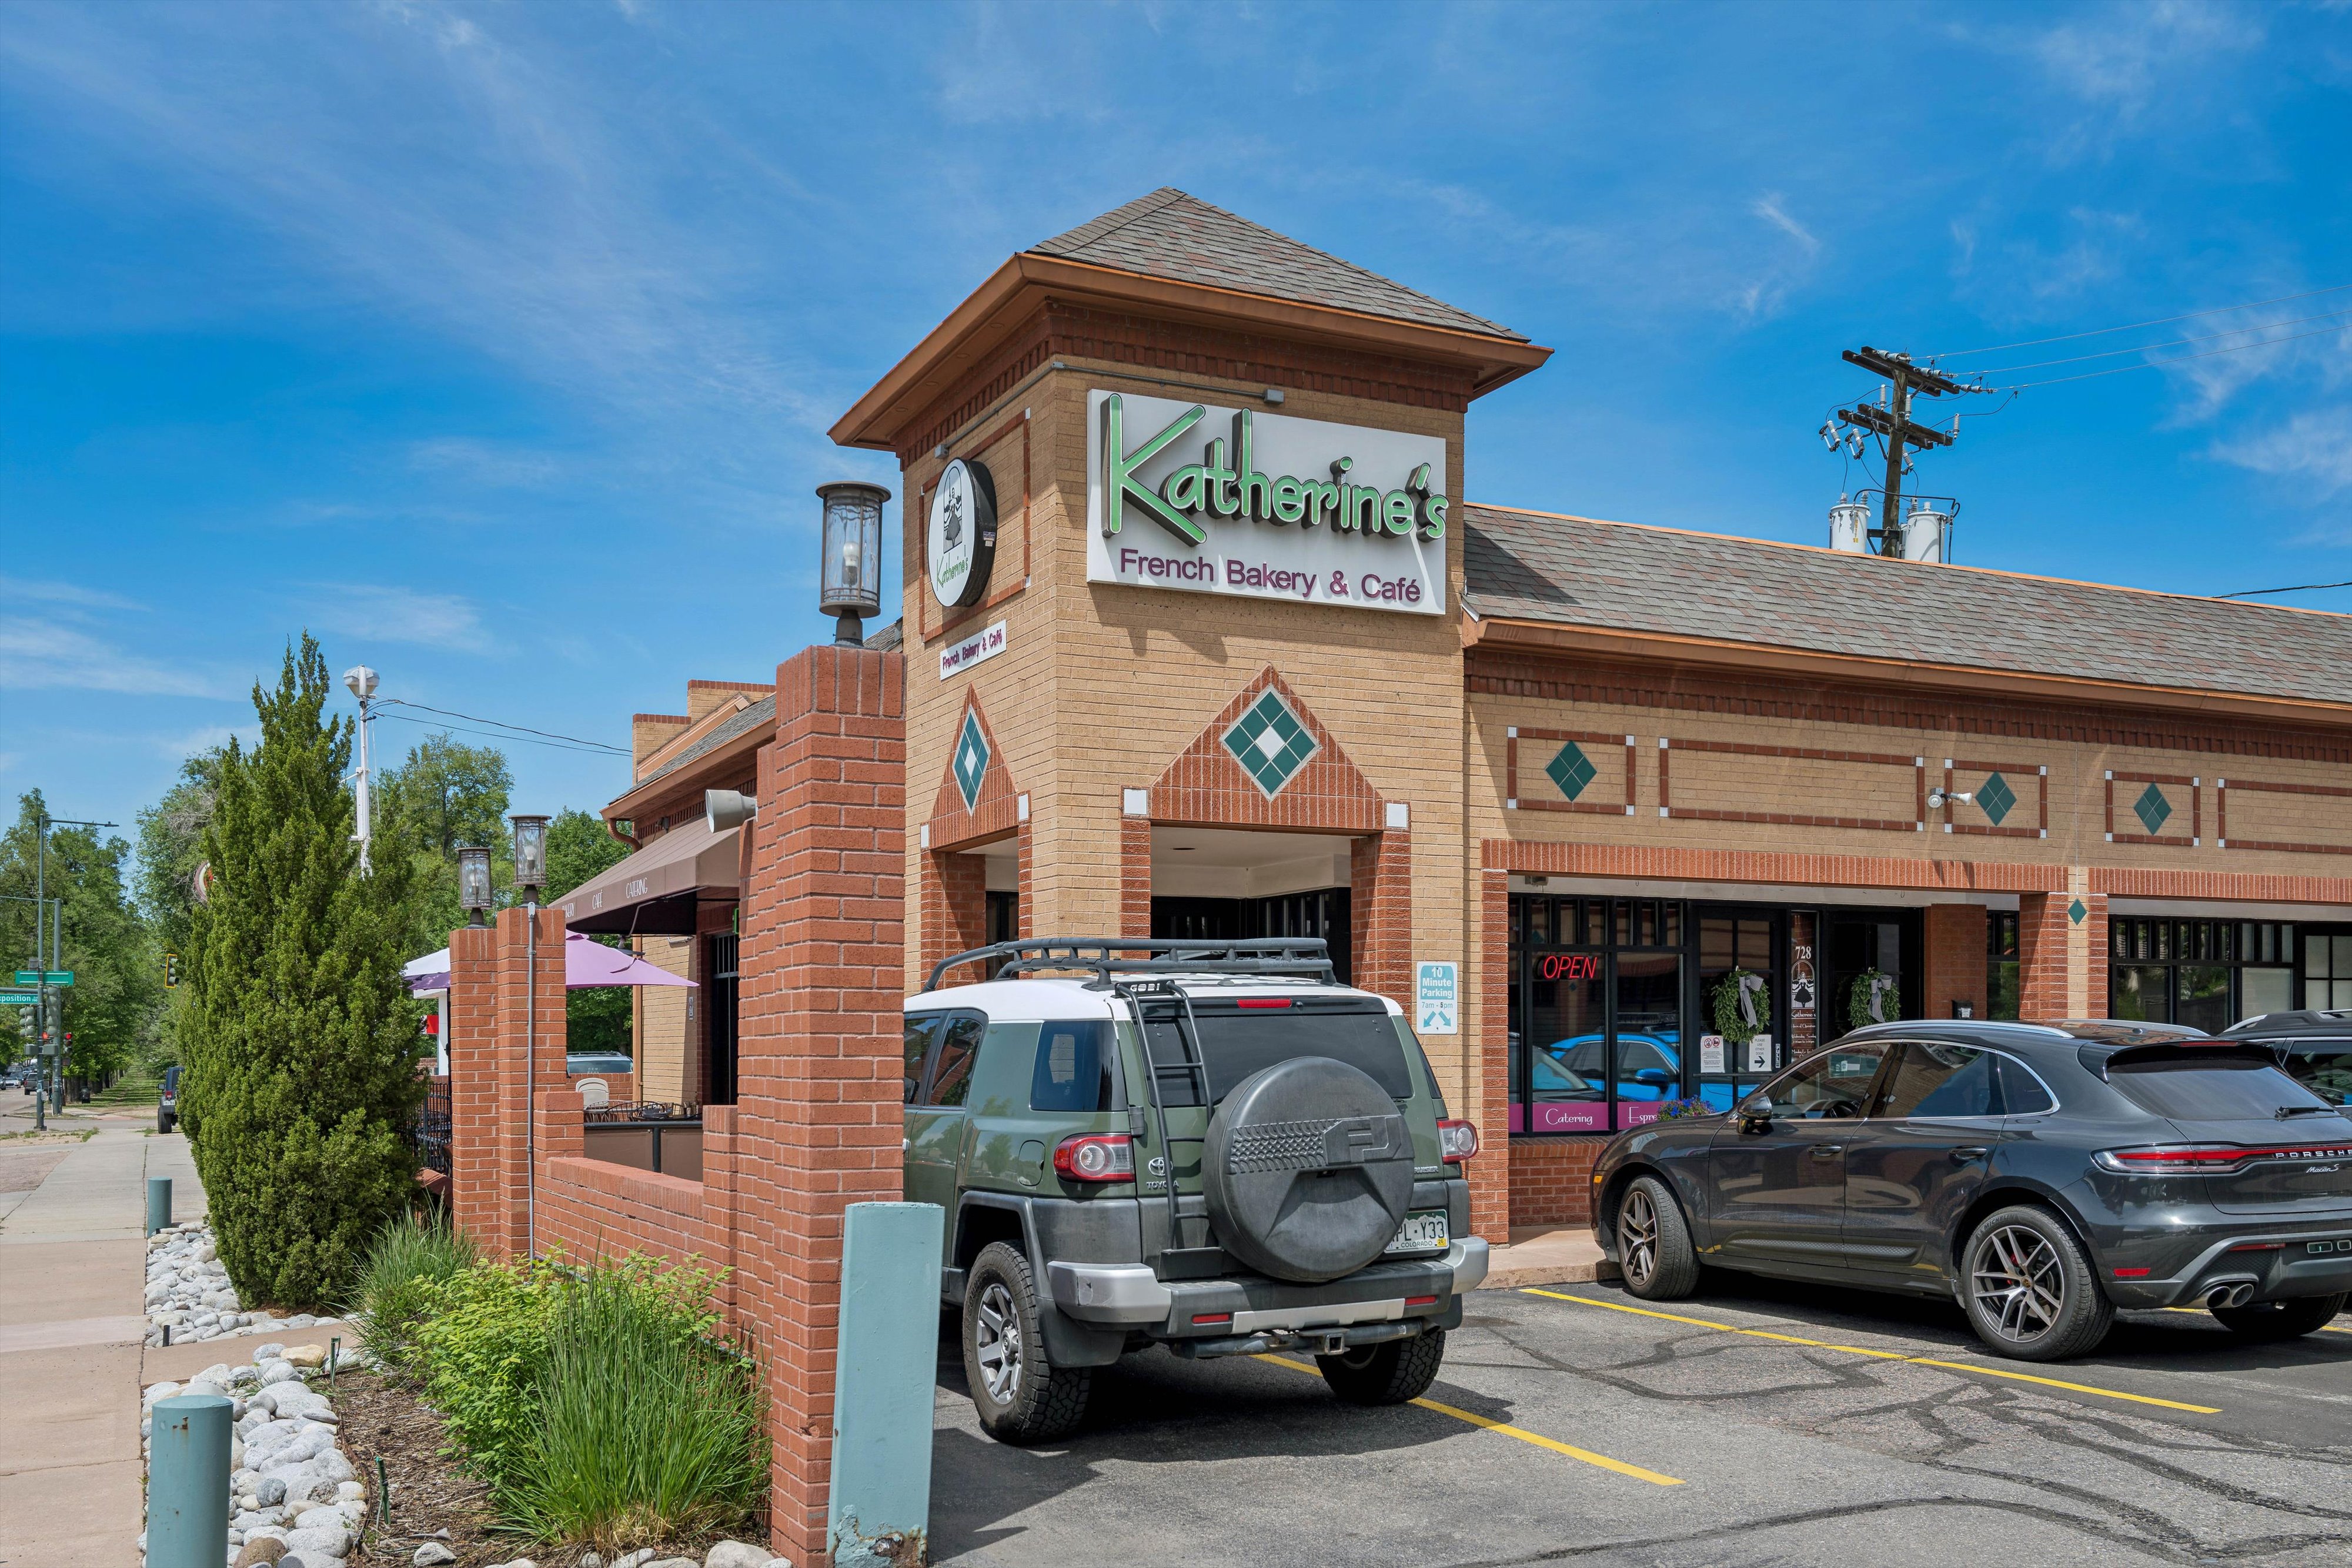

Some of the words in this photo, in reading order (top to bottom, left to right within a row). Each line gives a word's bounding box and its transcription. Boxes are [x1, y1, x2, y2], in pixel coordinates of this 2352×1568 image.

[1101, 393, 1449, 547] Katherine's
[937, 544, 968, 591] Katherine's
[1120, 548, 1214, 581] French
[1227, 559, 1317, 598] Bakery
[1330, 570, 1349, 594] &
[1361, 574, 1421, 603] Café
[943, 650, 960, 670] French
[962, 643, 980, 661] Bakery
[982, 637, 987, 651] &
[989, 628, 1003, 647] Café
[592, 890, 603, 910] CAFÉ
[626, 877, 648, 898] CATERING
[1795, 946, 1812, 959] 728
[1431, 967, 1443, 978] 10
[1544, 956, 1597, 978] OPEN
[1130, 983, 1160, 992] GOBI
[1422, 978, 1452, 987] Minute
[1422, 988, 1452, 998] Parking
[1545, 1108, 1593, 1125] Catering
[1628, 1106, 1658, 1124] Espre
[2275, 1149, 2352, 1159] PORSCHE
[1414, 1166, 1439, 1174] RUISER
[1146, 1180, 1180, 1189] TOYOA
[1983, 1213, 2016, 1231] MICHELIN
